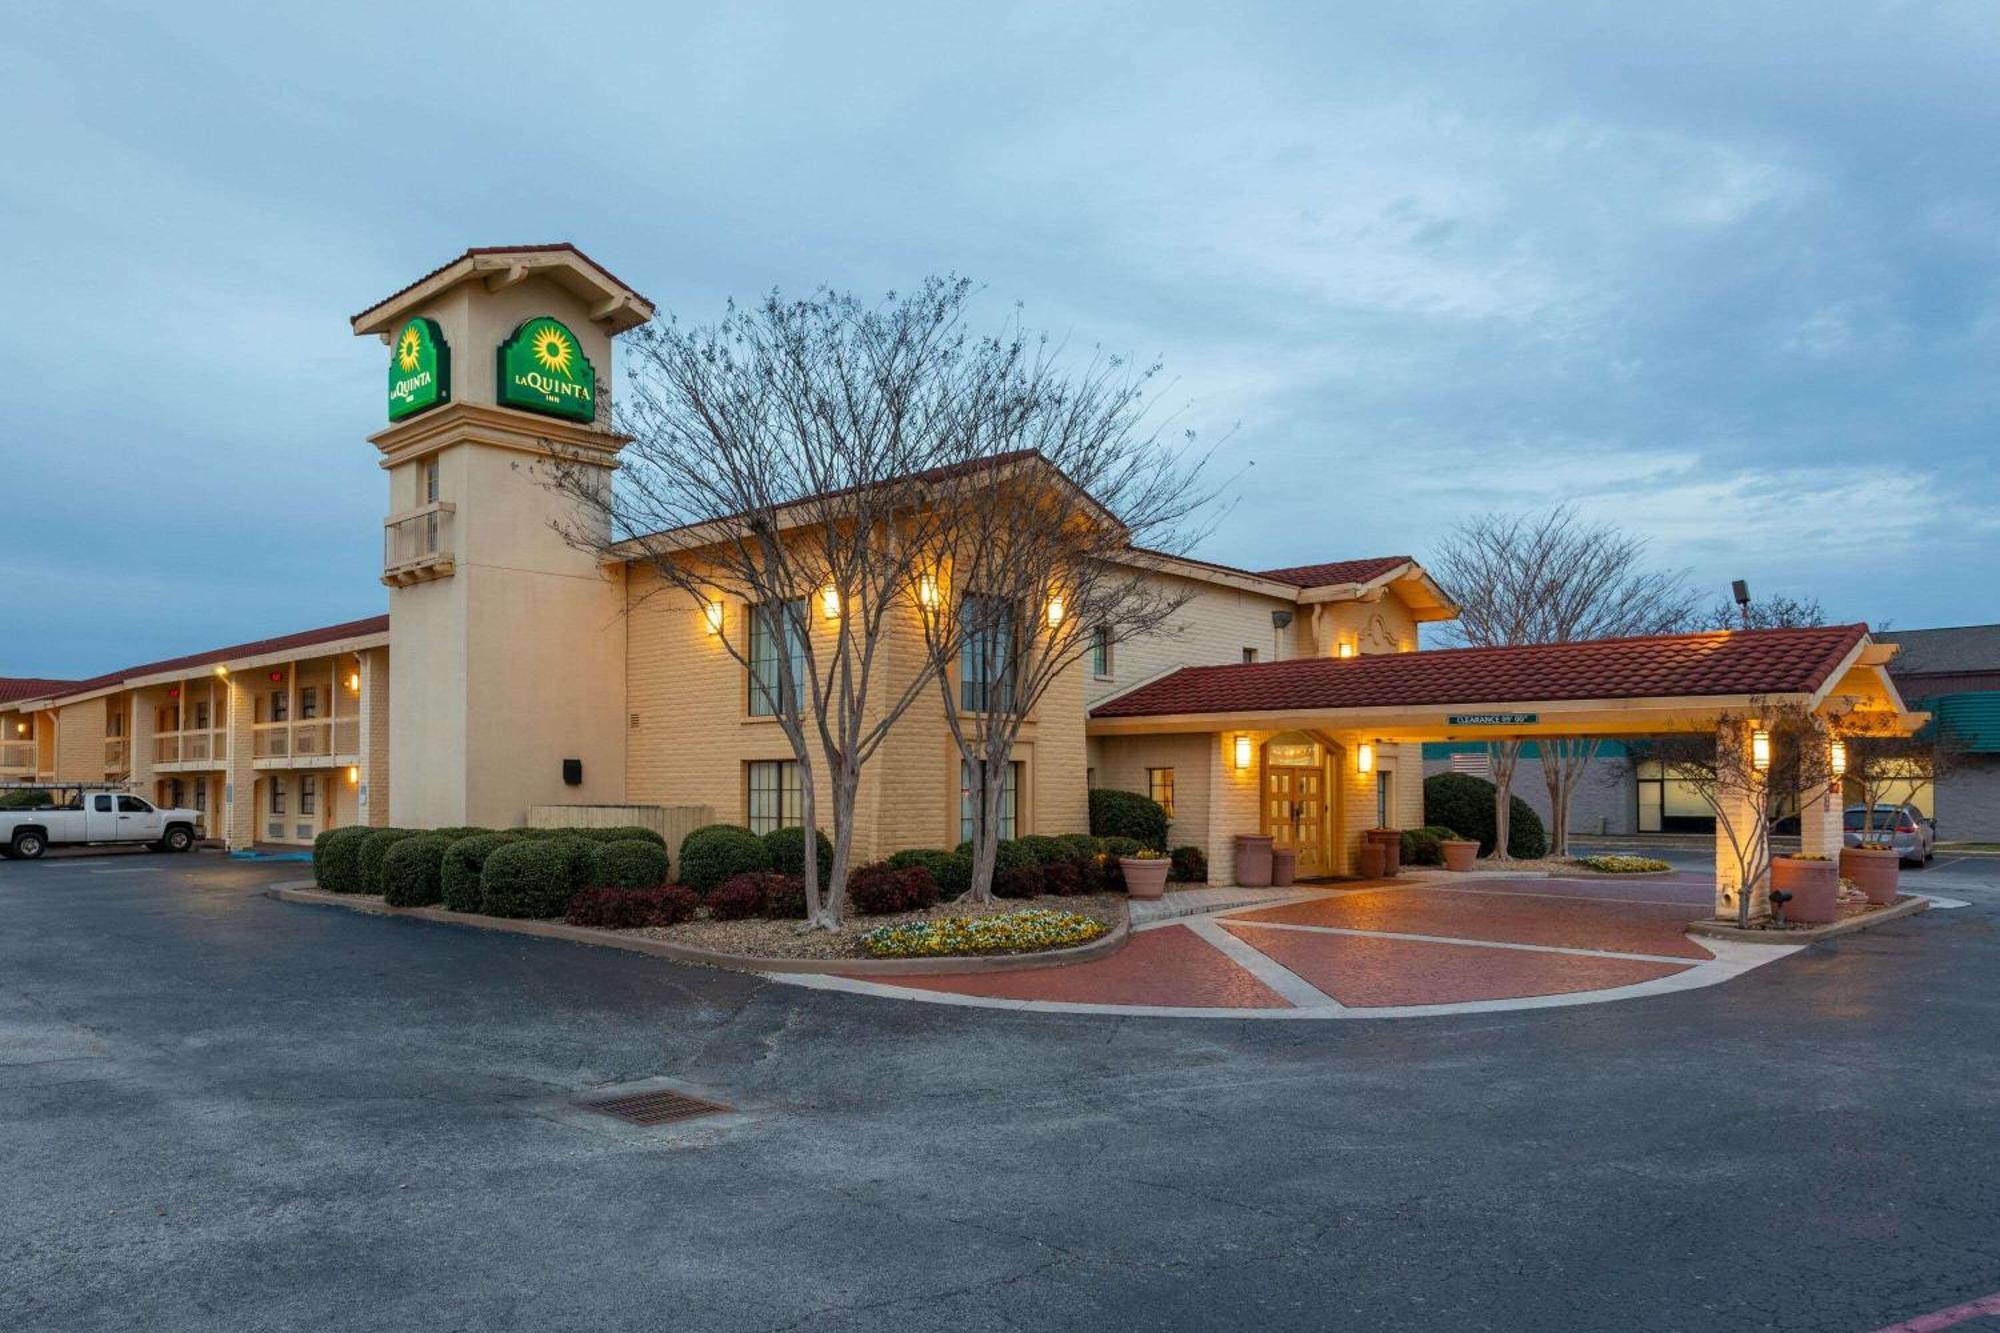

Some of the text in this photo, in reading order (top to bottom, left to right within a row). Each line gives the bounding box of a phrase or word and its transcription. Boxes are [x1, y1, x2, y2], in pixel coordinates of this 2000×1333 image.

[396, 371, 431, 396] QUINTA
[515, 372, 590, 400] LA QUINTA
